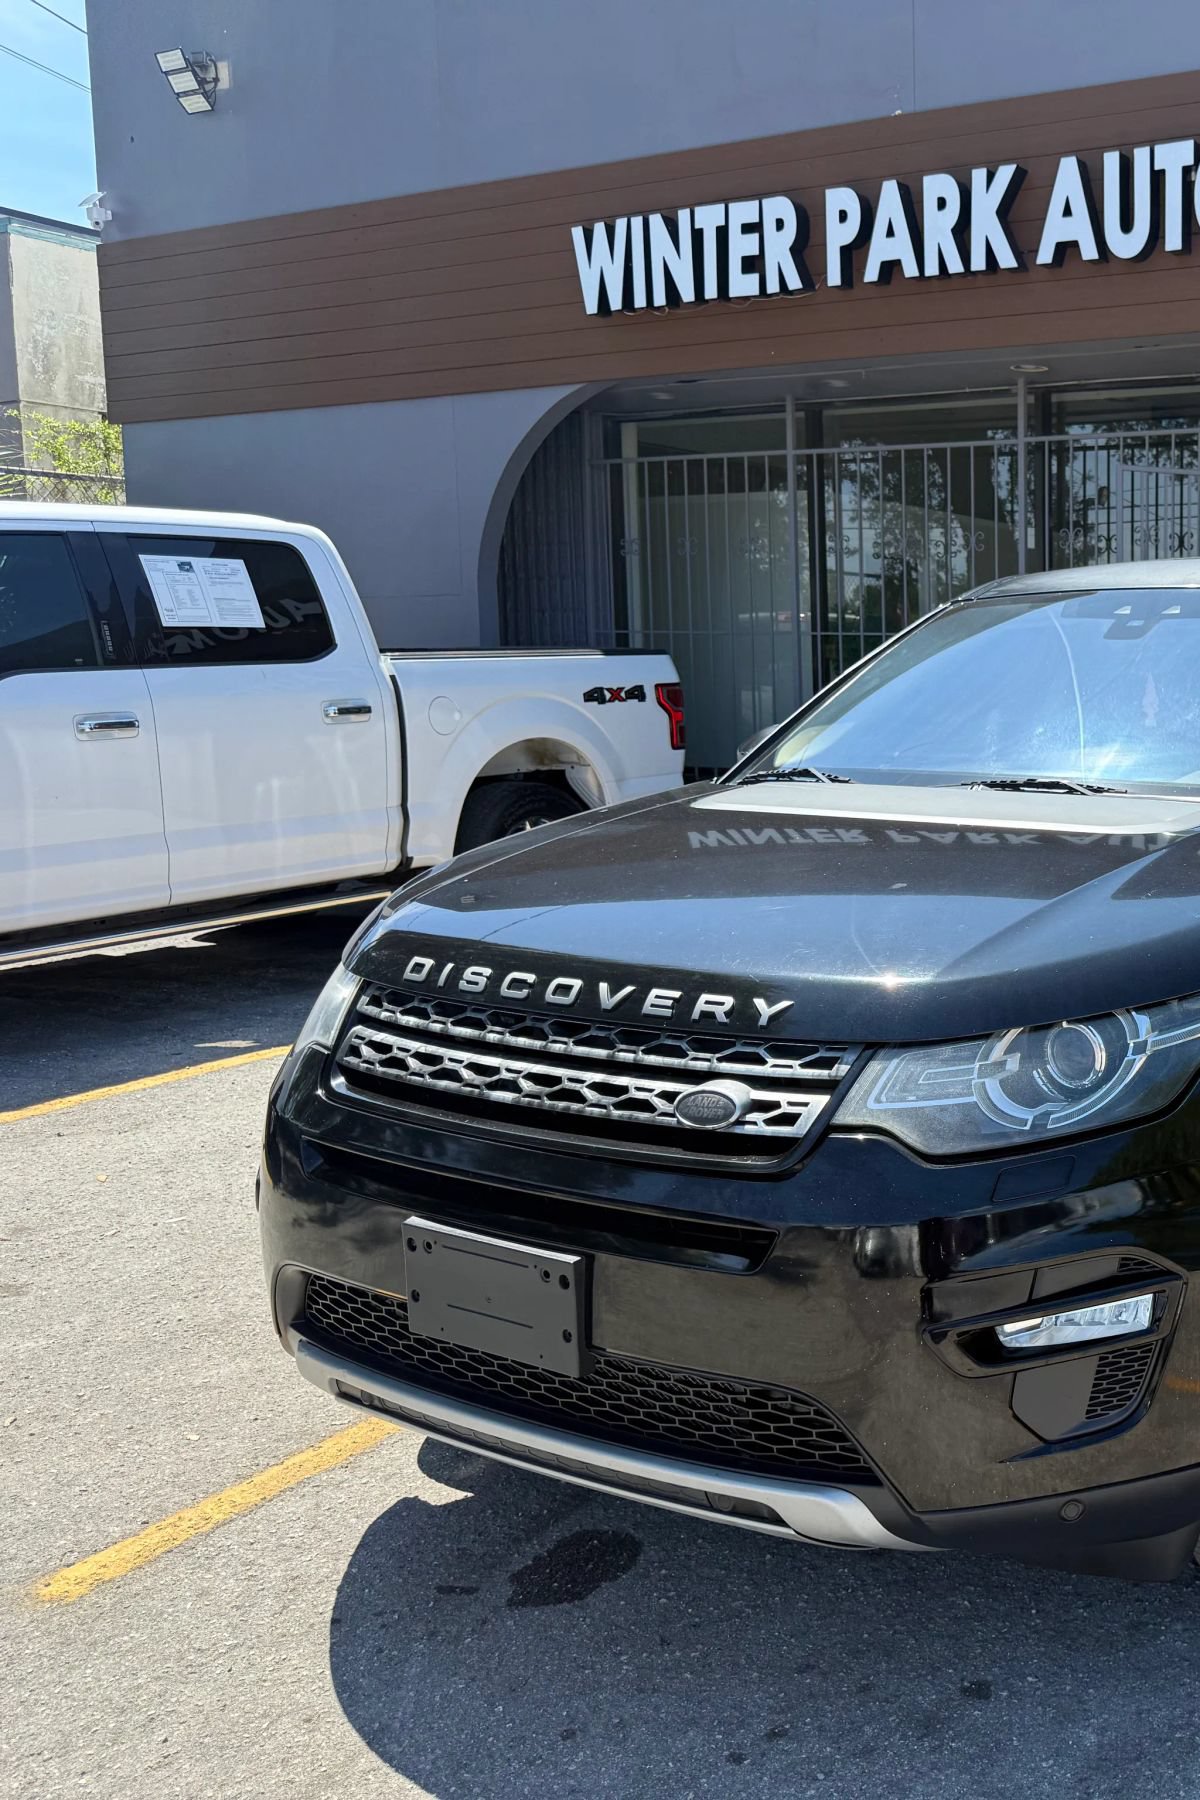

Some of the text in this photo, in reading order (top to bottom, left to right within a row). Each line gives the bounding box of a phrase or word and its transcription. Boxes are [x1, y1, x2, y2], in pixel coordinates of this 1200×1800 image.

[570, 195, 804, 316] WINTER
[824, 162, 1026, 290] PARK
[402, 955, 795, 1028] DISCOVERY
[686, 1095, 719, 1108] LAND
[687, 1105, 725, 1119] ROVER
